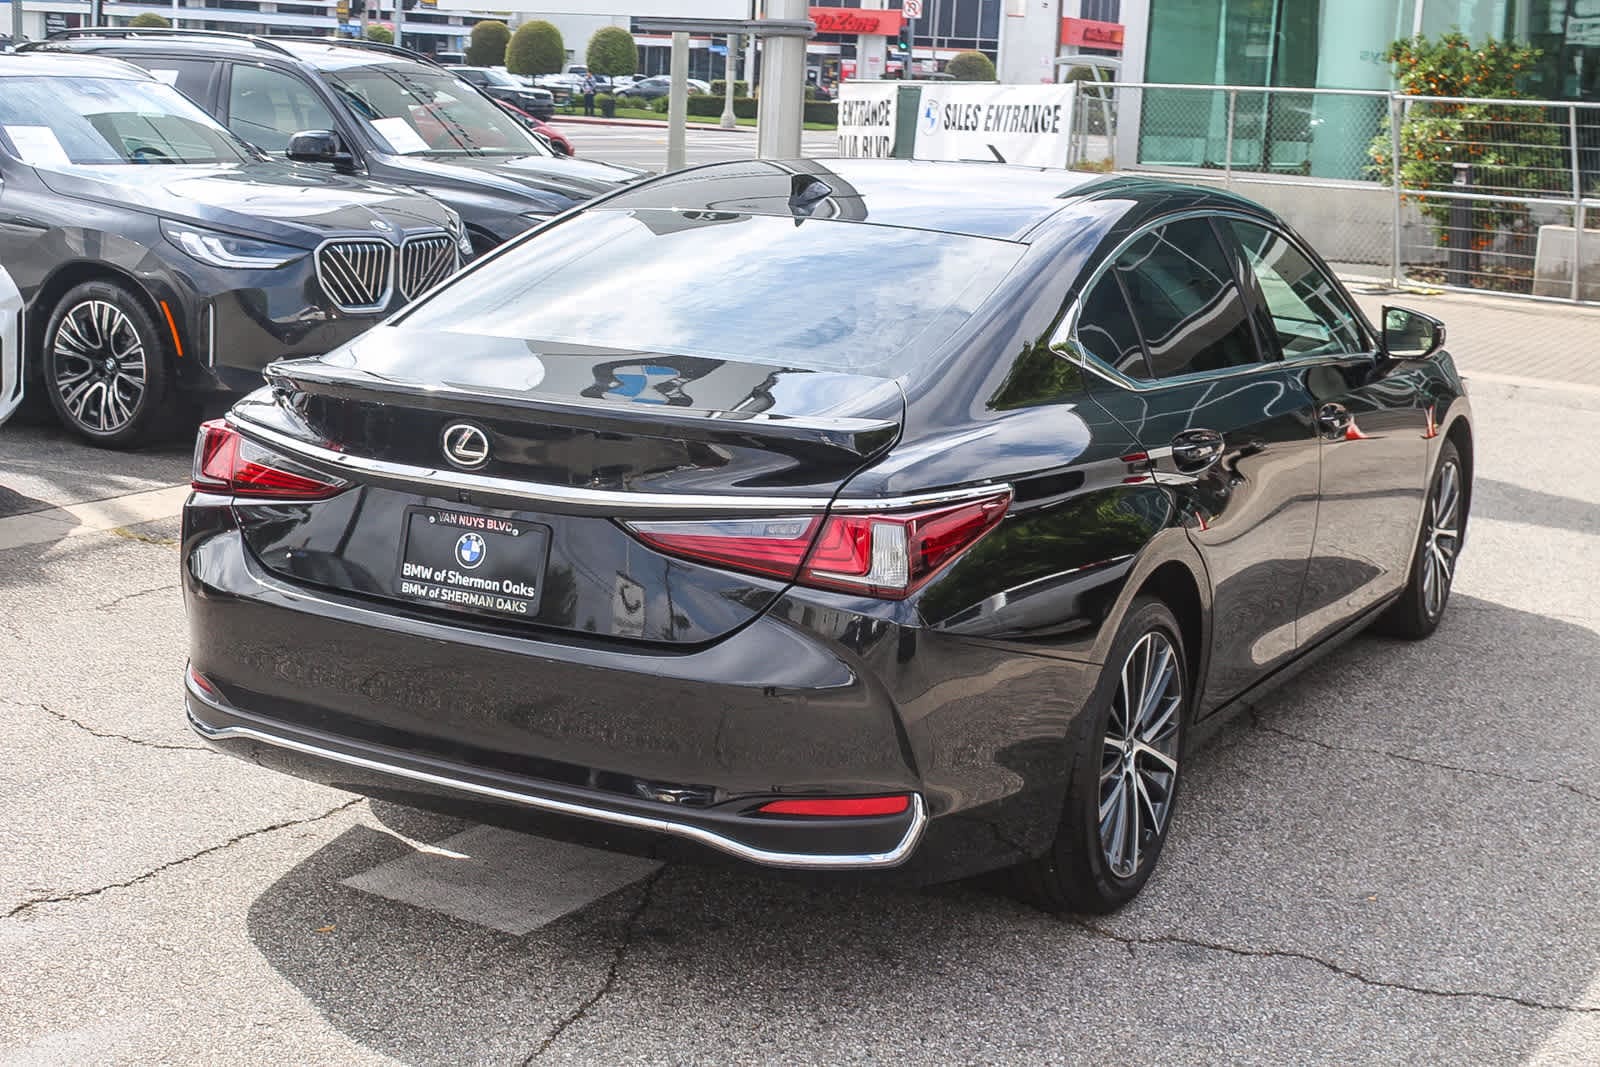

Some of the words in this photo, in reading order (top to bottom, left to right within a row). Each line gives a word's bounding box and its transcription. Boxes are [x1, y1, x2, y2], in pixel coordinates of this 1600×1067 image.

[842, 99, 891, 126] ENTRANCE
[943, 103, 981, 131] SALES
[984, 104, 1061, 133] ENTRANCE
[438, 511, 457, 524] VAN
[458, 515, 485, 529] NUYS
[486, 519, 513, 533] BLVD
[402, 562, 432, 580] BMW
[434, 569, 447, 581] of
[447, 570, 500, 592] Sherman
[502, 579, 536, 598] Oaks
[401, 582, 427, 596] BMW
[428, 588, 440, 599] of
[440, 588, 494, 608] SHERMAN
[496, 598, 528, 614] OAKS
